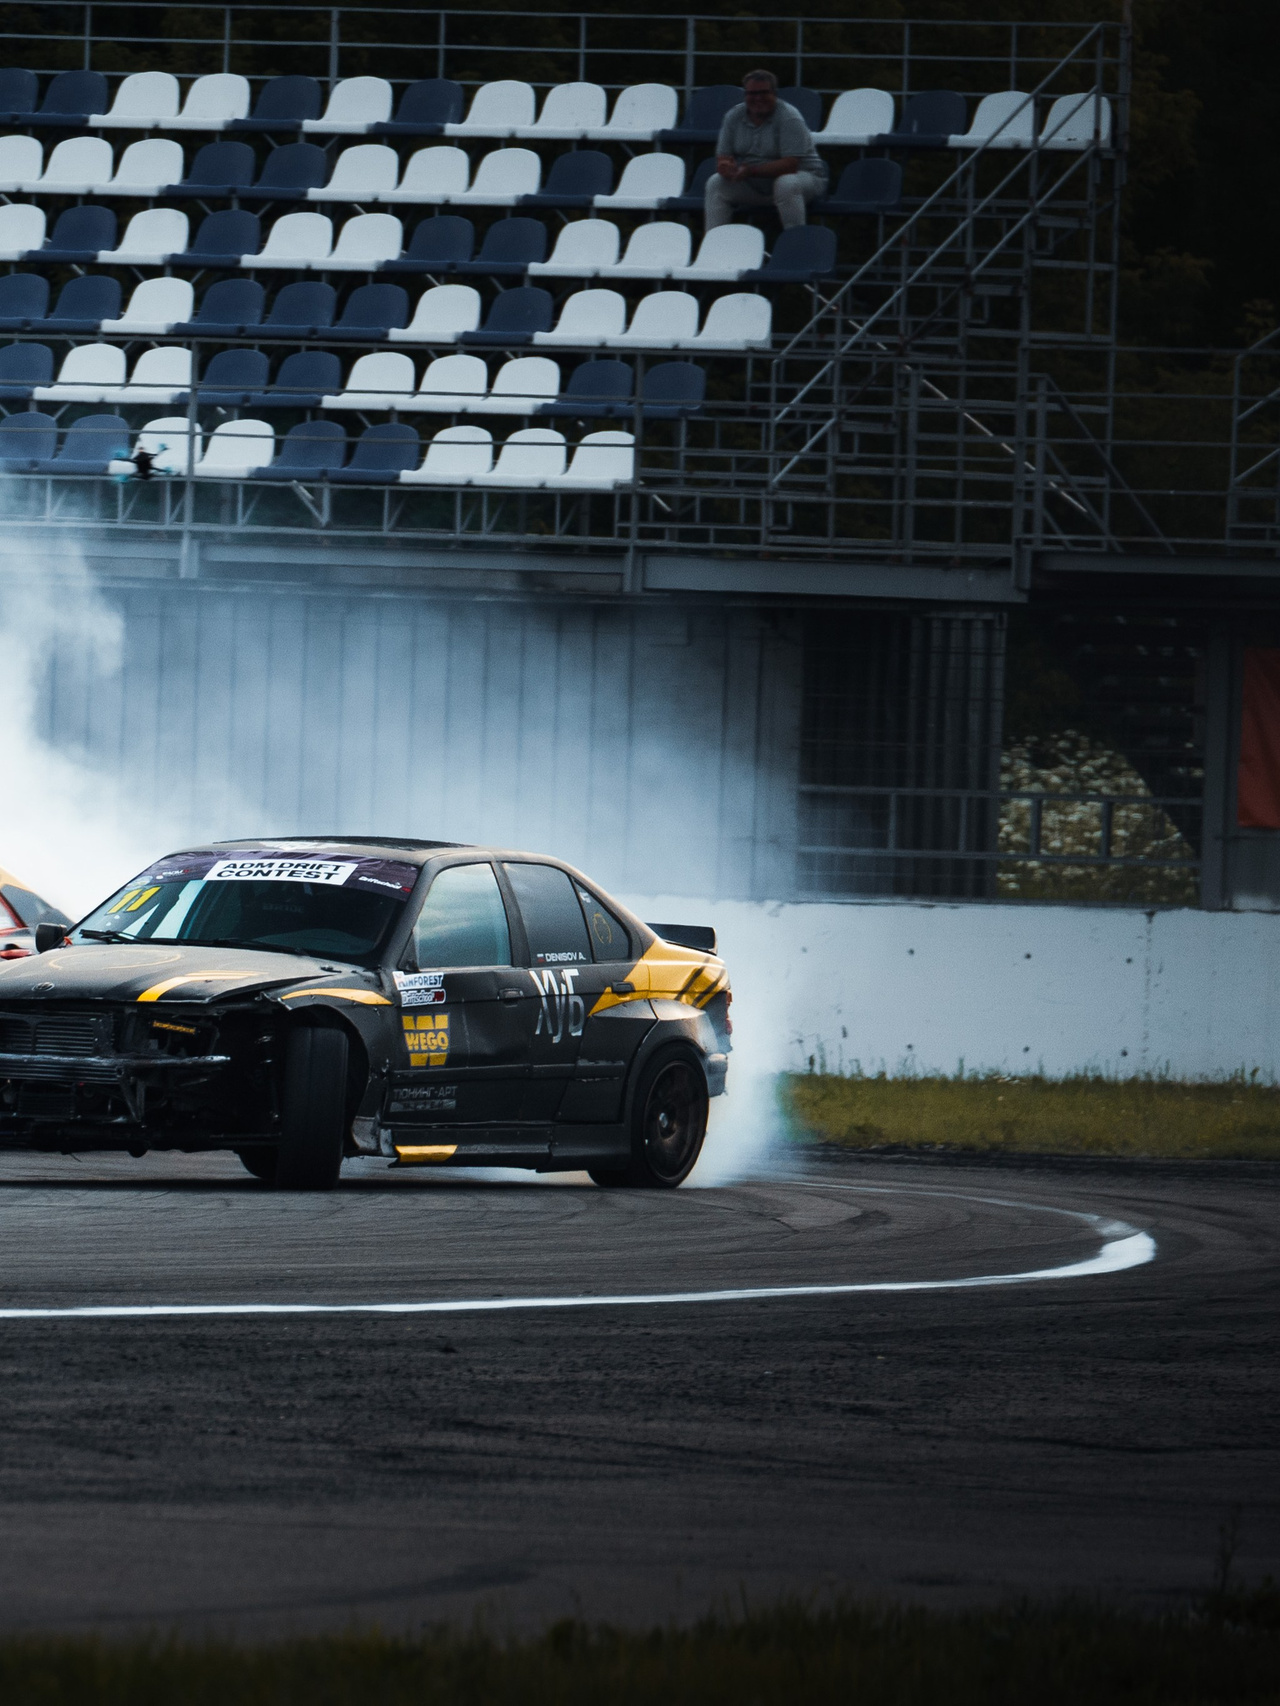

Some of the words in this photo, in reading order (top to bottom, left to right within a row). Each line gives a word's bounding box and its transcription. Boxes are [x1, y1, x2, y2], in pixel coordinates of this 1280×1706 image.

[223, 862, 276, 870] ADM
[278, 862, 347, 872] DRIFT
[216, 869, 341, 880] CONTEST
[106, 886, 162, 914] 11
[545, 952, 577, 962] DENISOV
[404, 1031, 449, 1050] WEGO
